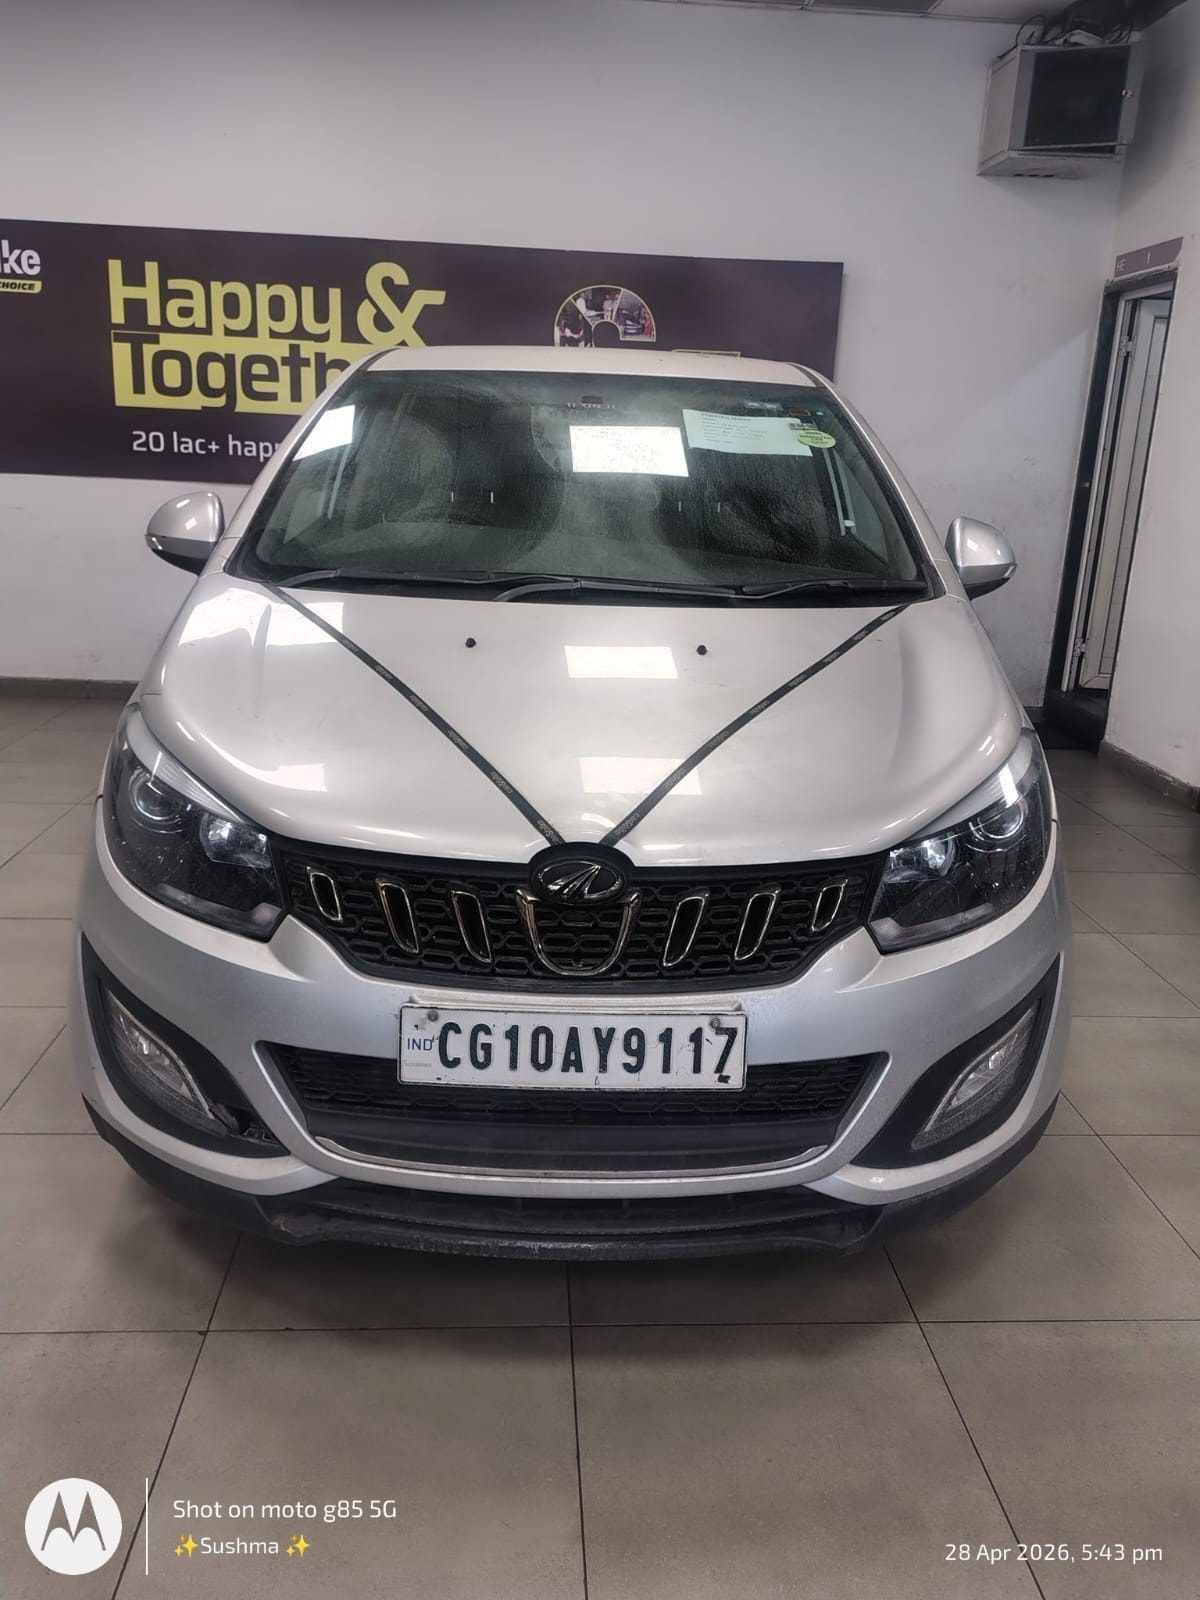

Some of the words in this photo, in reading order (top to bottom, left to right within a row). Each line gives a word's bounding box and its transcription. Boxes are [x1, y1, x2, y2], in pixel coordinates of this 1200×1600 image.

[0, 239, 41, 275] ke
[107, 259, 342, 342] Happy
[357, 261, 446, 347] &
[132, 430, 165, 453] 20
[173, 431, 220, 455] lac+
[228, 433, 281, 462] hap
[407, 1037, 433, 1051] IND
[438, 1022, 738, 1074] CG10AY9117
